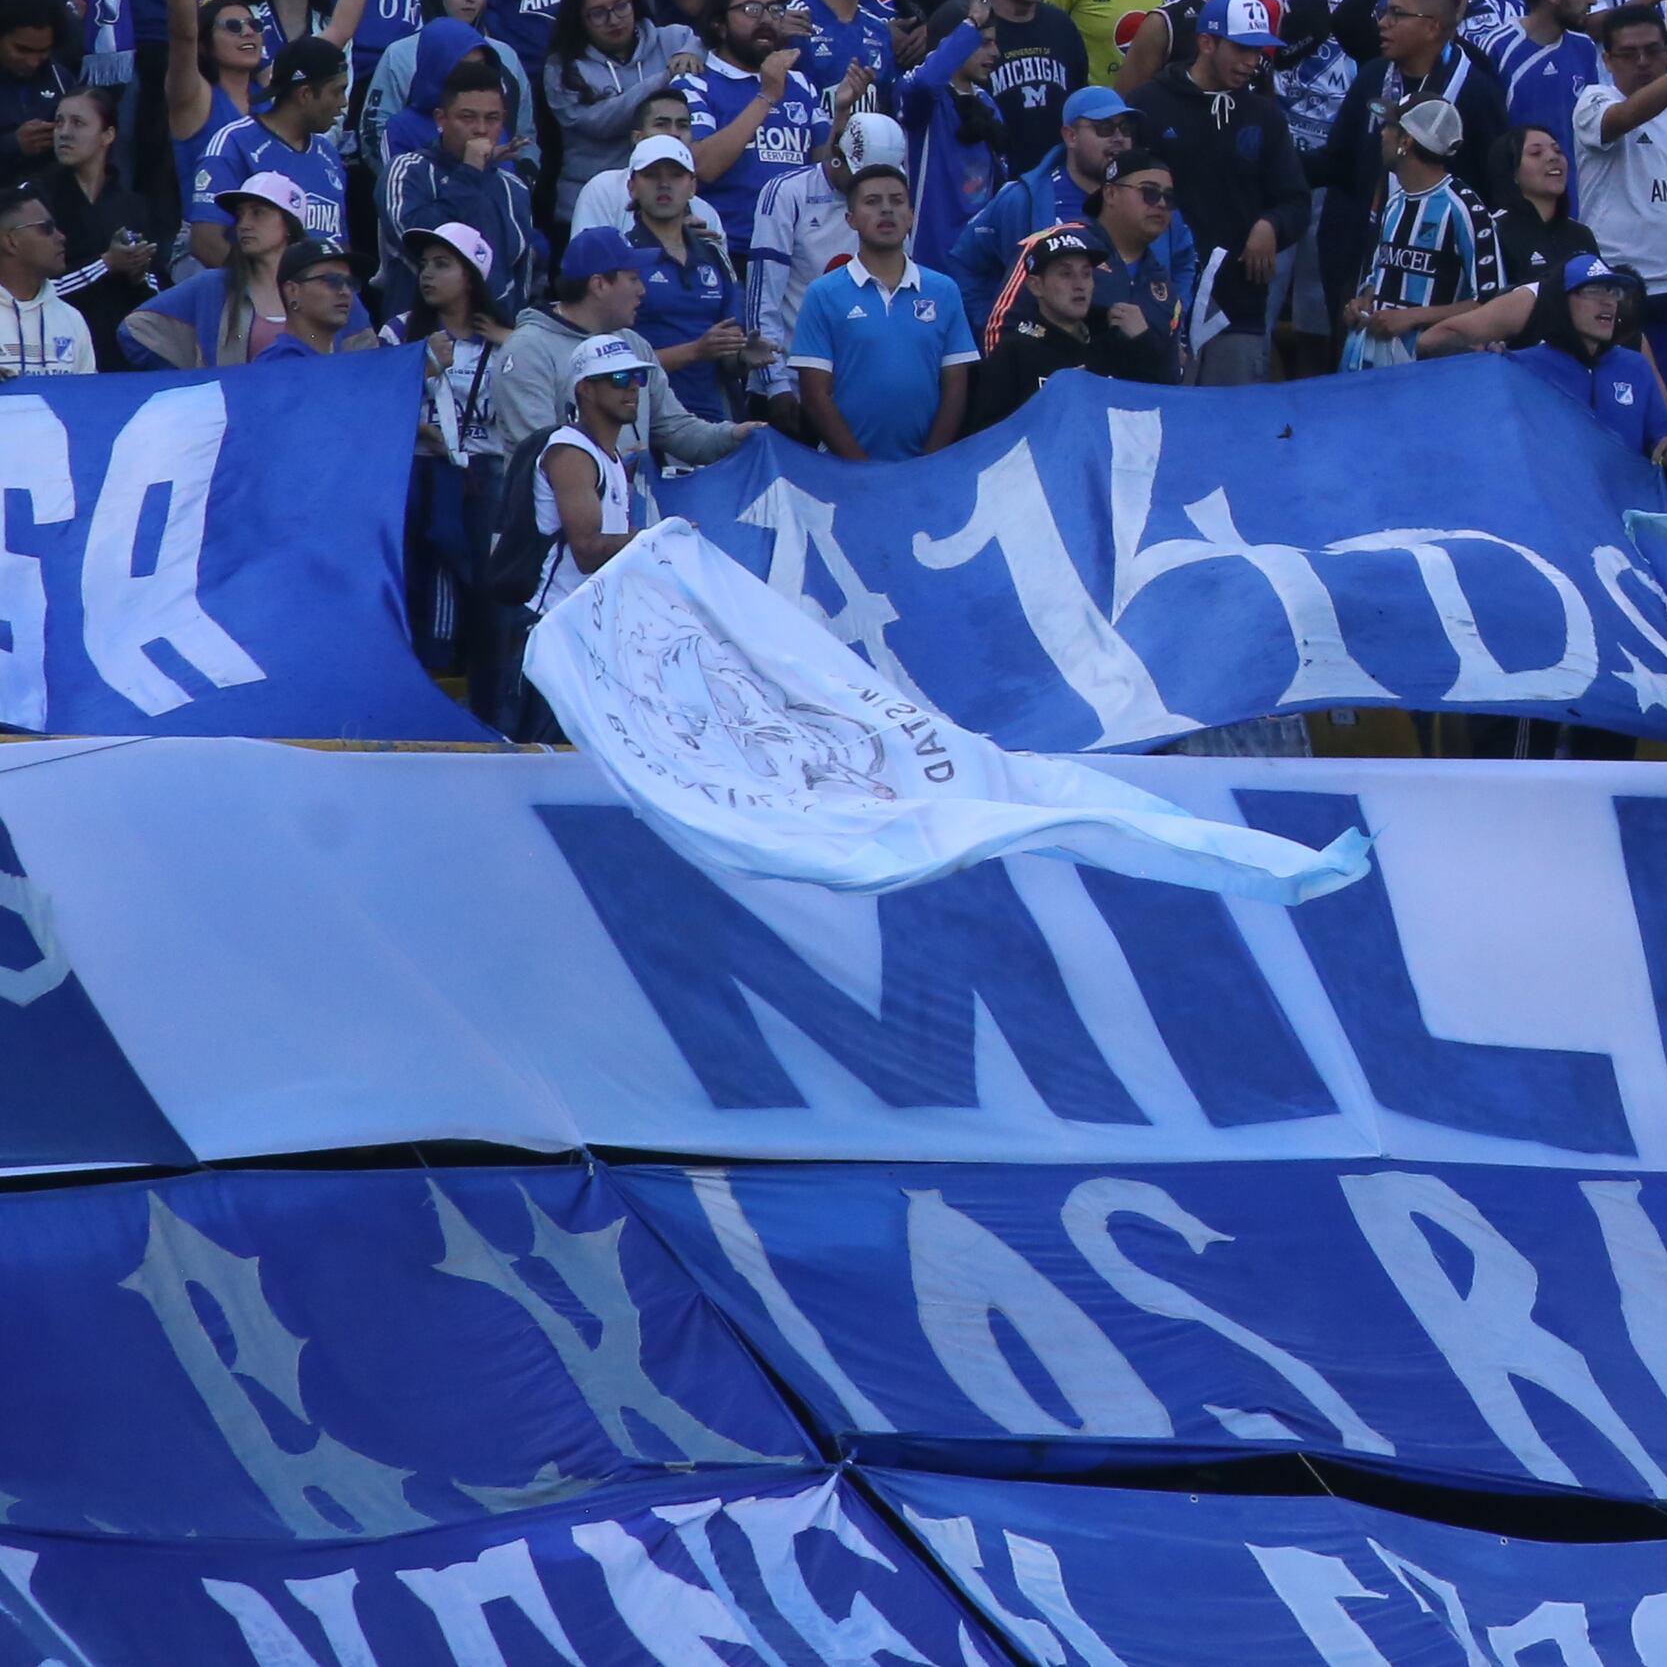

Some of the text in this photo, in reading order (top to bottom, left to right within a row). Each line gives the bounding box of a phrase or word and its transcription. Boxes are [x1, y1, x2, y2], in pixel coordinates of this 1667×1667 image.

[1242, 2, 1266, 21] 77
[989, 58, 1067, 97] MICHIGAN
[1021, 85, 1048, 108] M
[758, 149, 804, 164] CERVEZA
[305, 203, 341, 235] DINA
